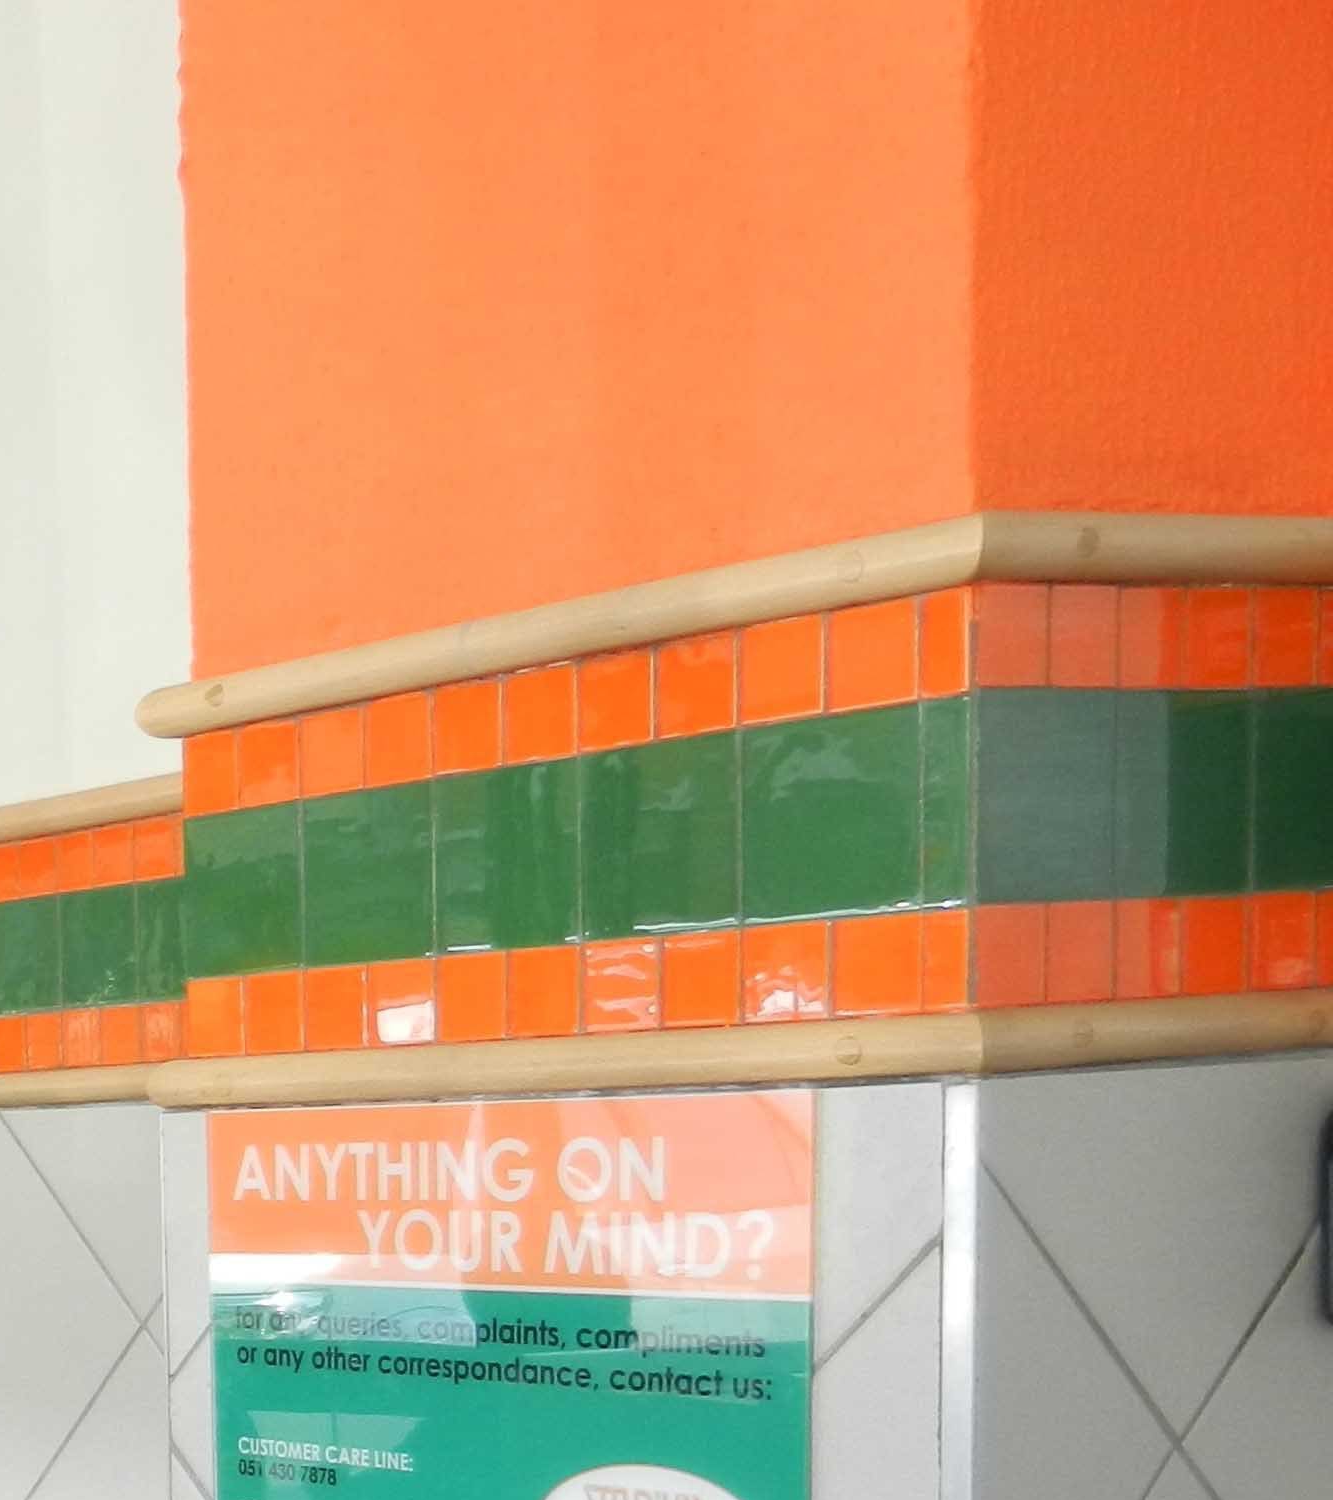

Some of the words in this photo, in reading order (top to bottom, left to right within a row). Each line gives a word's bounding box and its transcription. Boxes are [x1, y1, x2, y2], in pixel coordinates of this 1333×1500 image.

[234, 1137, 534, 1203] ANYTHING
[558, 1136, 666, 1203] ON
[357, 1208, 524, 1273] YOUR
[544, 1210, 775, 1281] MIND?
[236, 1306, 263, 1331] for
[417, 1317, 566, 1350] complaints,
[576, 1325, 766, 1359] compliments
[237, 1346, 258, 1365] or
[264, 1347, 305, 1374] any
[312, 1345, 371, 1373] other
[378, 1353, 599, 1392] correspondance,
[609, 1366, 724, 1397] contact
[733, 1376, 773, 1401] us:
[238, 1436, 320, 1463] CUSTOMER
[325, 1446, 370, 1467] CARE
[375, 1450, 414, 1472] LINE:
[238, 1459, 263, 1477] 051
[300, 1465, 337, 1486] 7878
